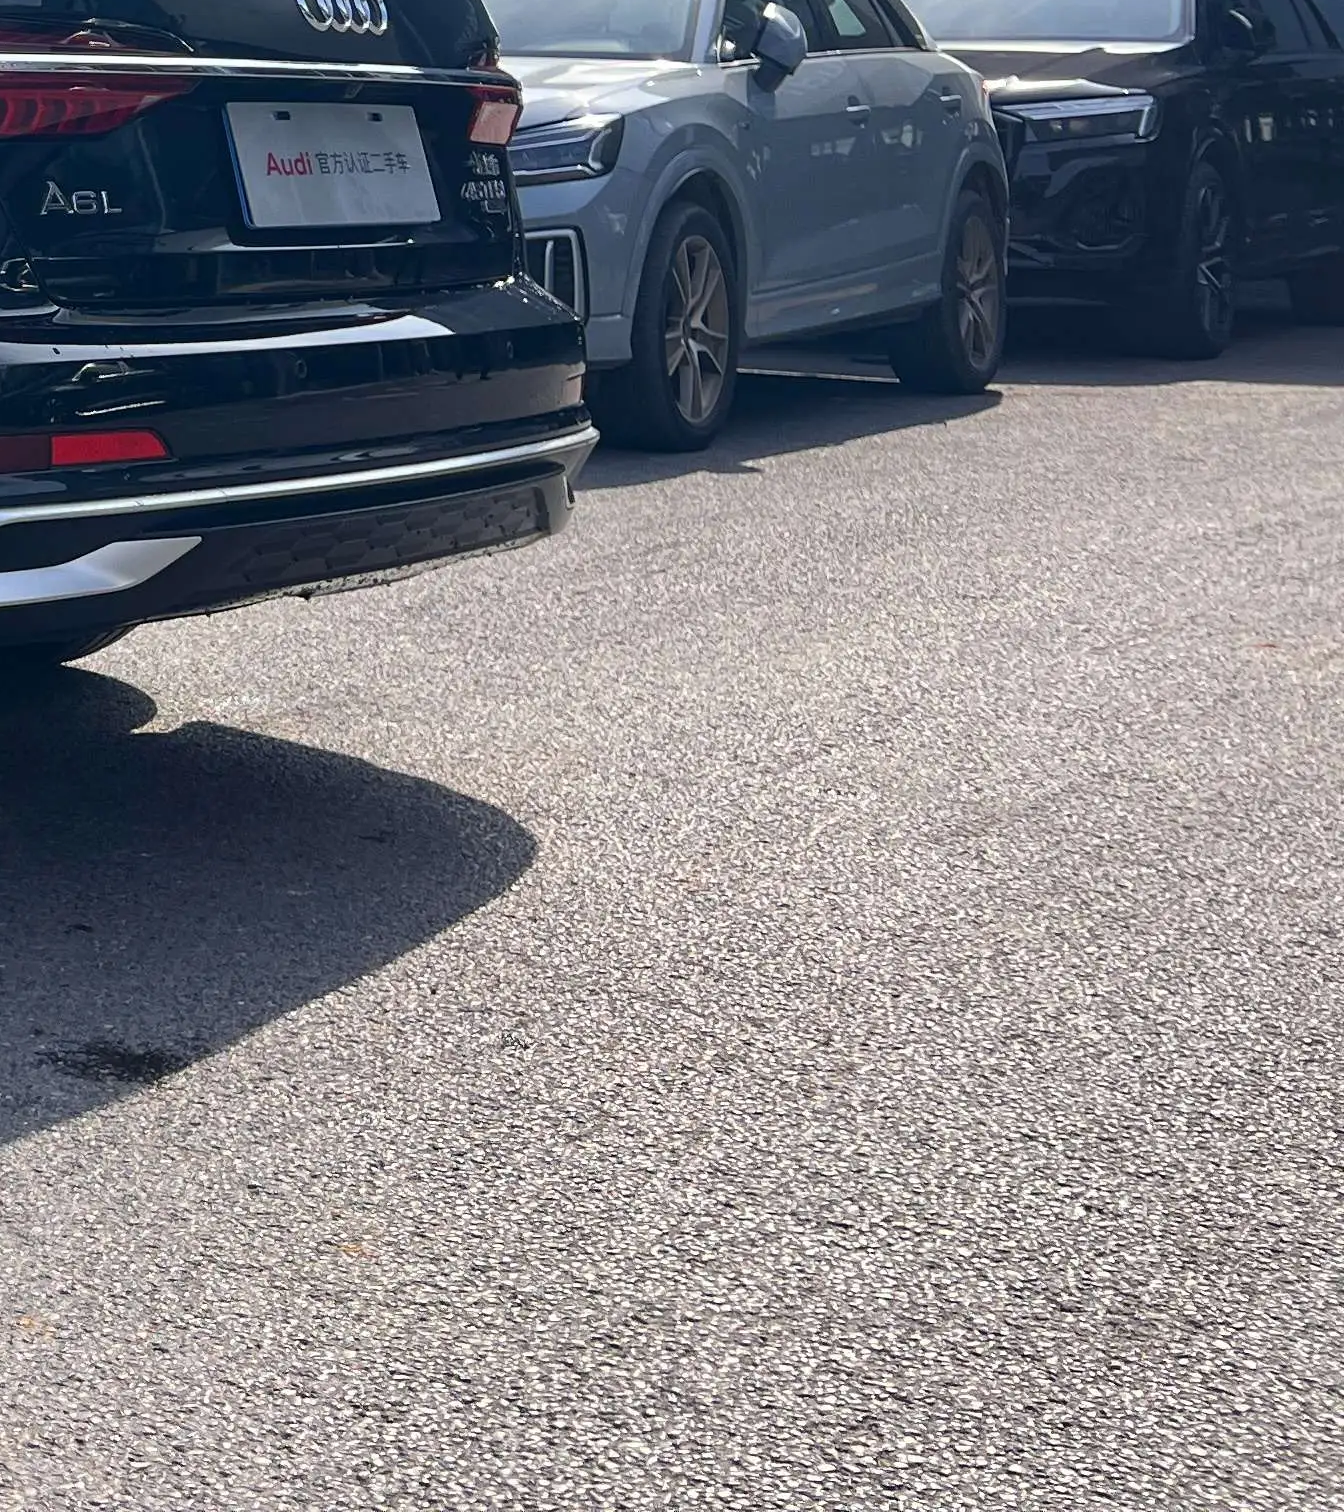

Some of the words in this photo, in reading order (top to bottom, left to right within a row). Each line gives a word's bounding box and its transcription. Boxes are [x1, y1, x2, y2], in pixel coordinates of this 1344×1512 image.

[266, 151, 313, 177] Audi
[315, 151, 412, 175] 官方认证二手车
[39, 180, 123, 216] A6L
